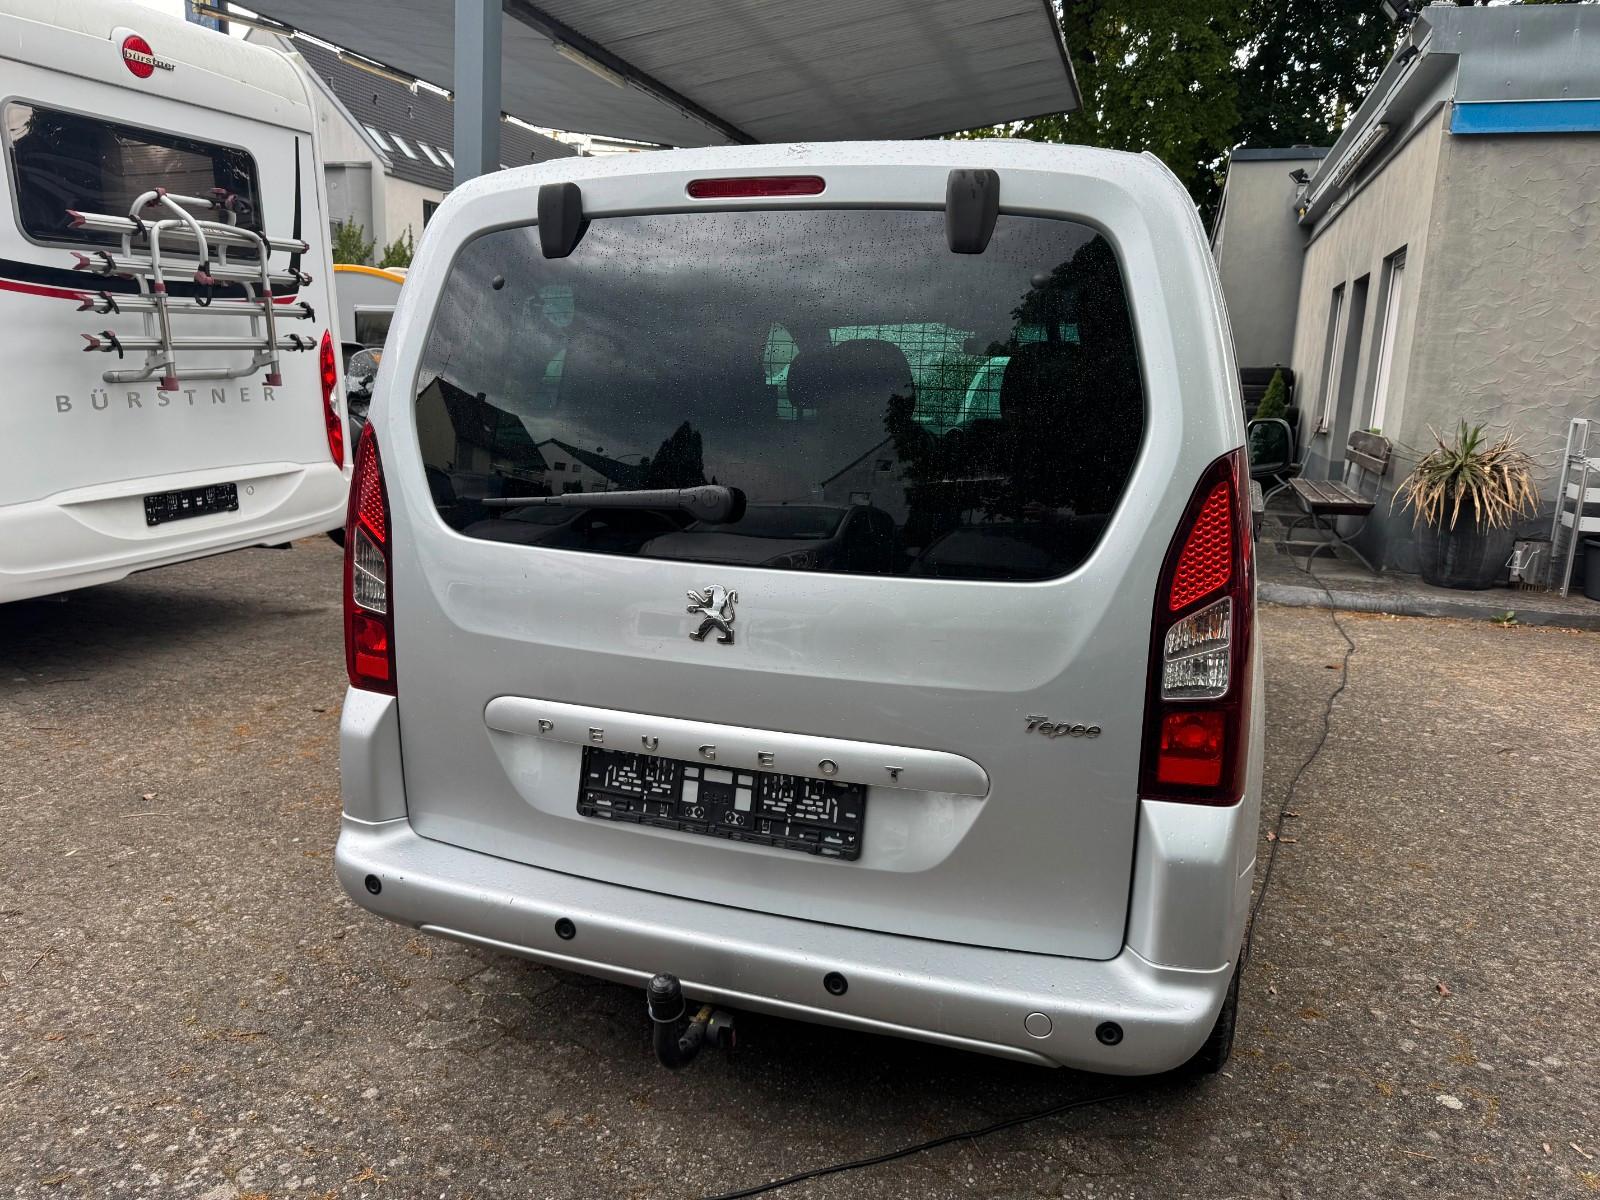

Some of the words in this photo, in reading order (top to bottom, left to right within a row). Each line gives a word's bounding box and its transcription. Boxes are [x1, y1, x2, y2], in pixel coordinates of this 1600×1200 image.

[124, 48, 176, 72] bürstner
[56, 387, 276, 413] BÜRSTNER
[1025, 714, 1101, 740] Tepee
[538, 718, 904, 783] PEUGEOT
